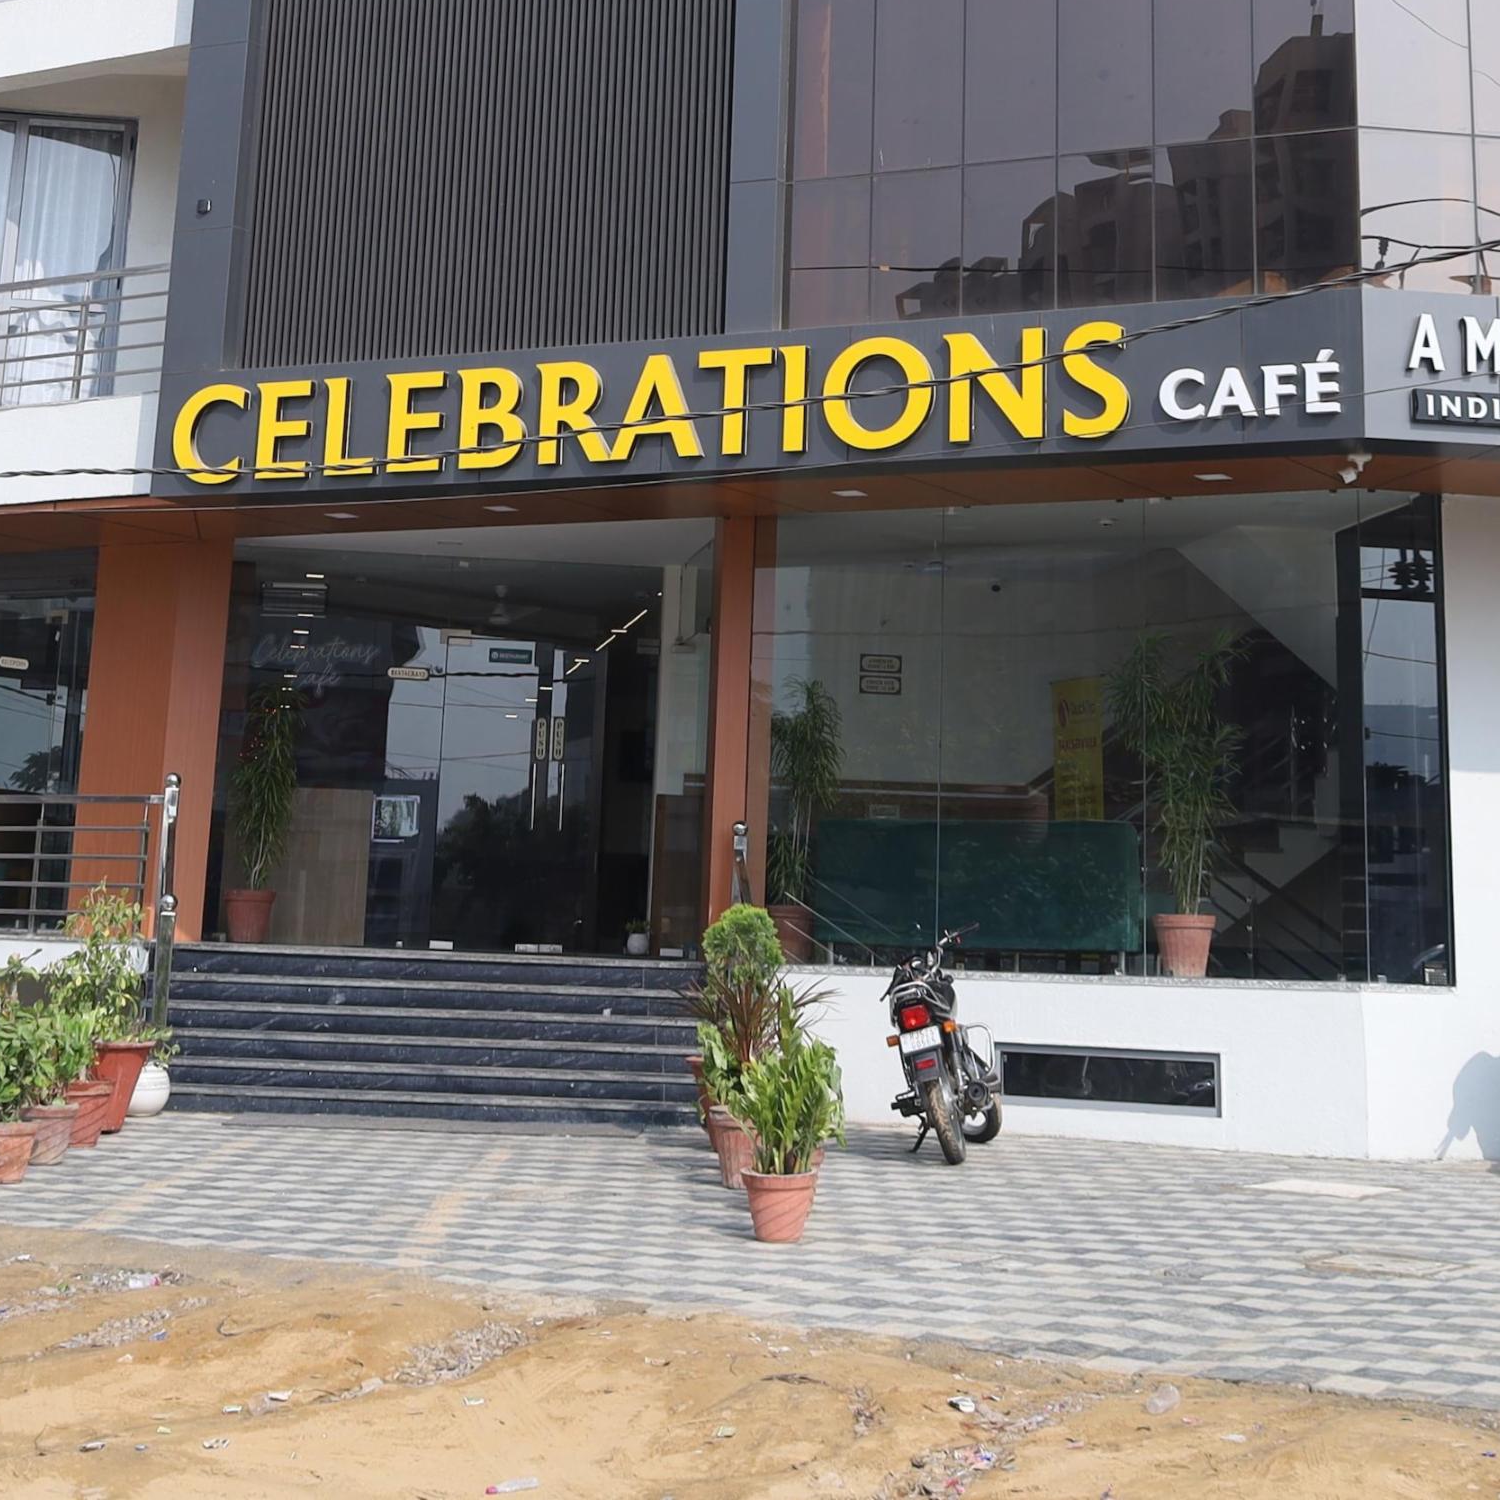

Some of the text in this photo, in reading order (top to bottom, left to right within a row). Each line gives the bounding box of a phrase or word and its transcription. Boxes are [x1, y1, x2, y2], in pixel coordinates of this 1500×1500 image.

[1407, 312, 1446, 373] A
[171, 320, 1343, 486] CELEBRATIONS CAFÉ
